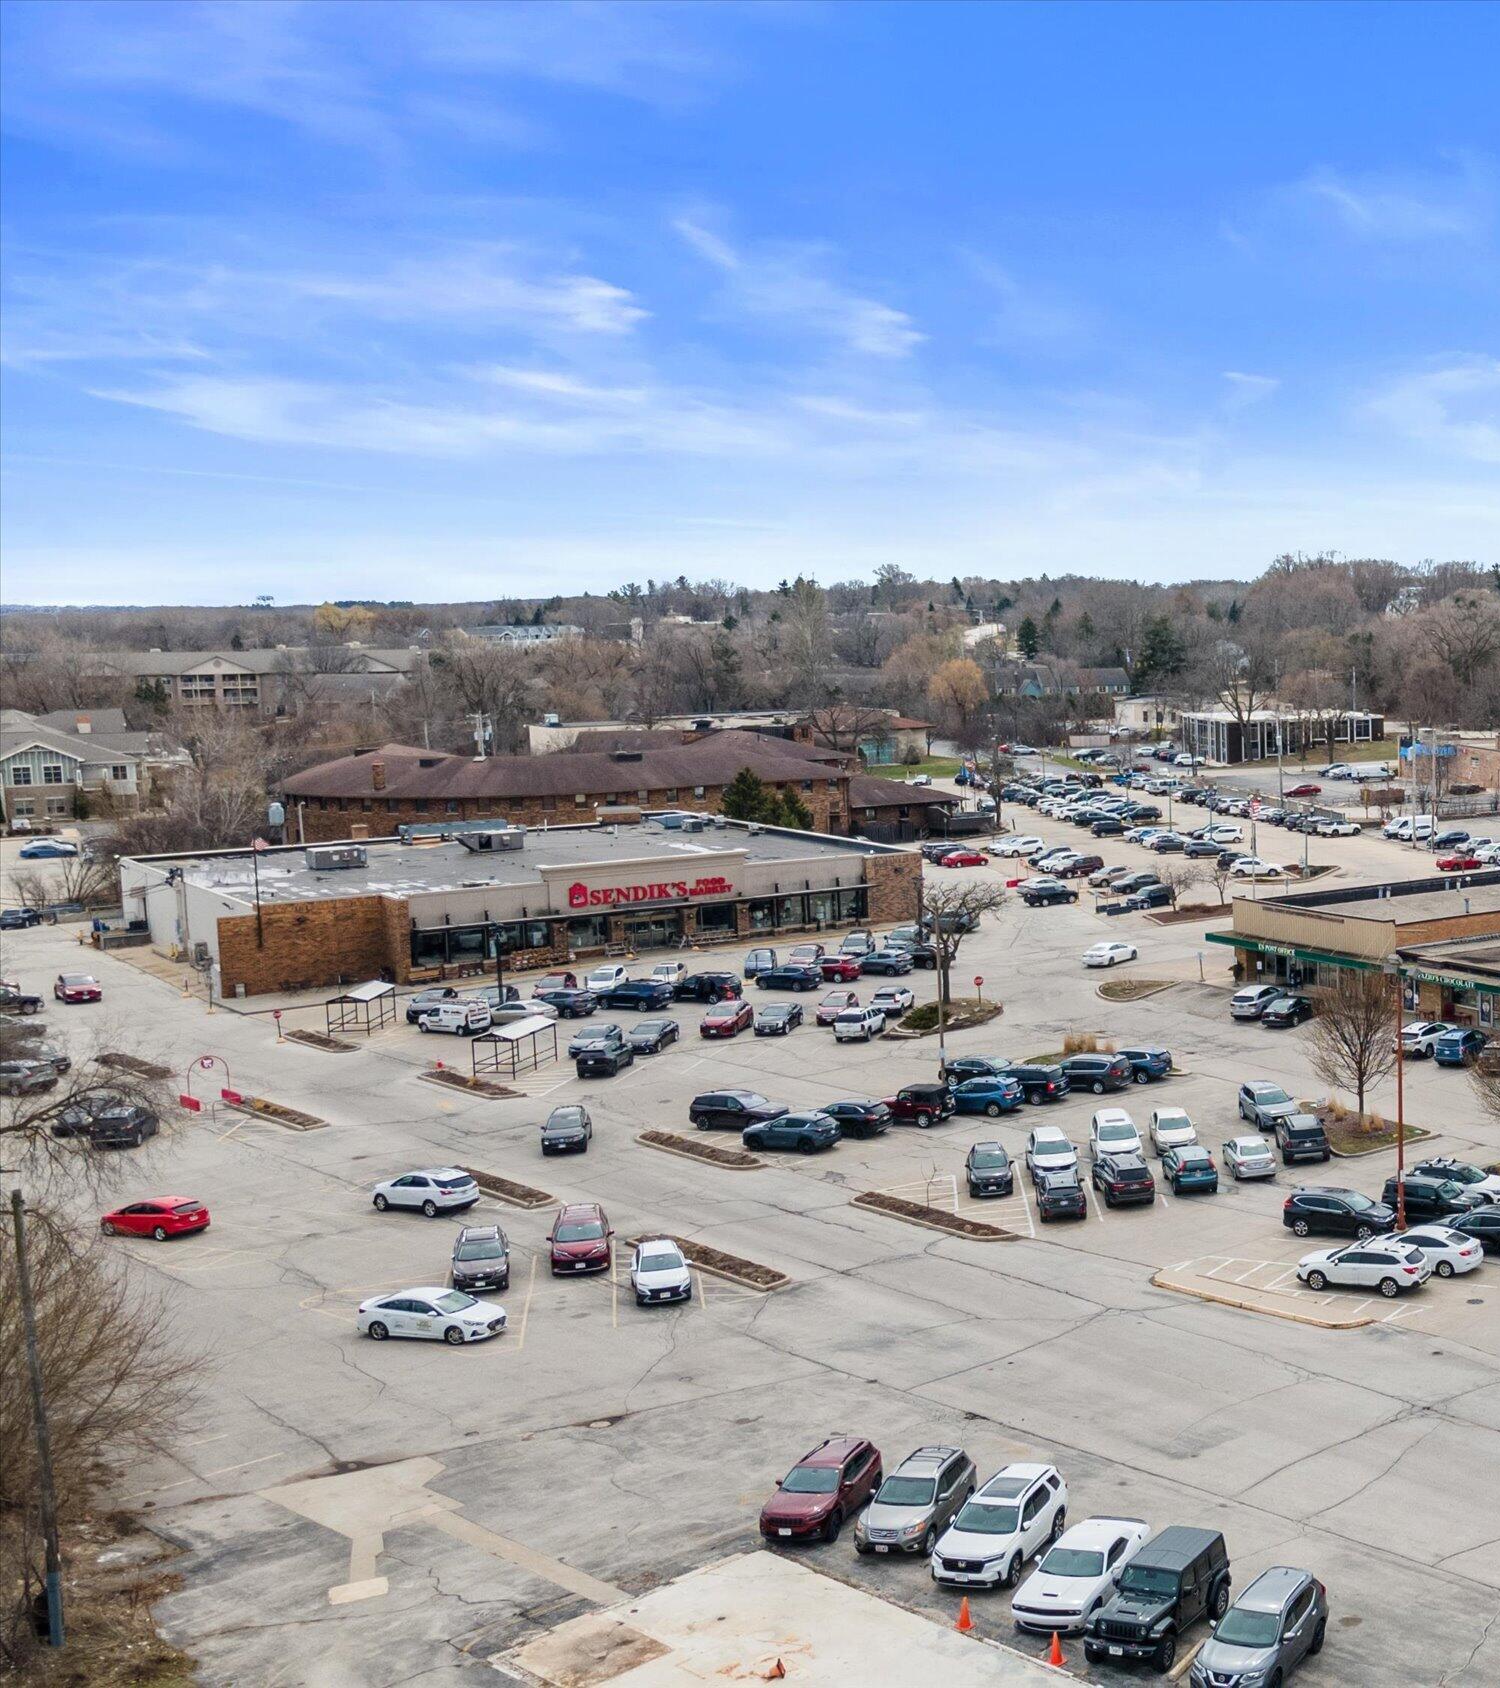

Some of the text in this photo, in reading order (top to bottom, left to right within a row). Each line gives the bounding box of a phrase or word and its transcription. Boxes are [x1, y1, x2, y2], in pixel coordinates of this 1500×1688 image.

[696, 877, 725, 887] FOOD
[590, 882, 687, 905] SENDIK'S
[689, 884, 733, 896] MARKET
[1277, 947, 1295, 956] OFFICE
